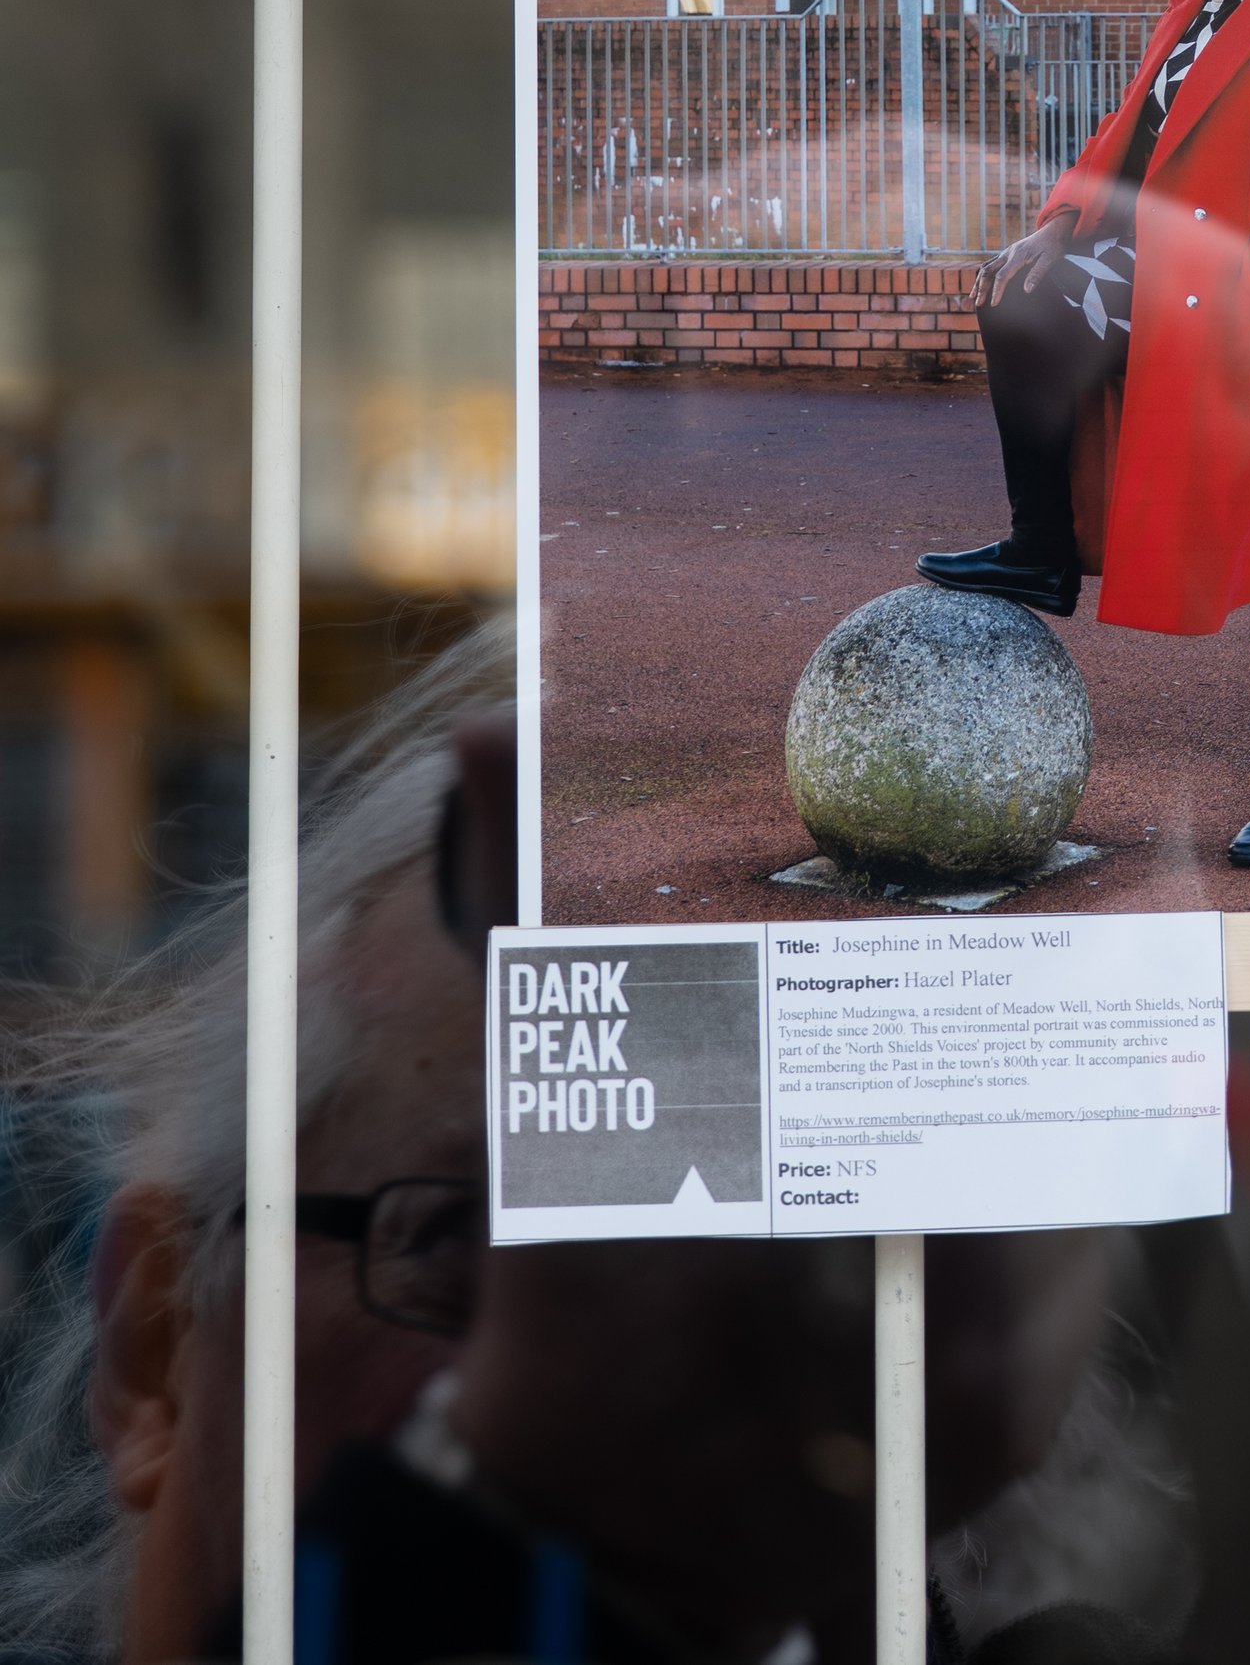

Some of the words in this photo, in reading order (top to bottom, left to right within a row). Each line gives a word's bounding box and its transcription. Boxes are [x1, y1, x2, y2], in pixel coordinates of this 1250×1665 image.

[776, 940, 820, 954] Title:
[832, 935, 920, 956] Josephine
[926, 936, 942, 950] in
[948, 933, 1025, 950] Meadow
[1031, 931, 1071, 947] Well
[509, 961, 630, 1015] DARK
[776, 975, 899, 993] Photographer:
[904, 971, 954, 988] Hazel
[961, 971, 1012, 987] Plater
[778, 1007, 838, 1023] Josephine
[842, 1006, 919, 1022] Mudzingwa,
[923, 1009, 930, 1017] a
[933, 1005, 981, 1017] resident
[986, 1003, 1000, 1015] of
[1002, 1001, 1055, 1015] Meadow
[1060, 1000, 1092, 1014] Well,
[1096, 999, 1131, 1012] North
[1135, 998, 1184, 1012] Shields,
[1188, 996, 1224, 1009] North
[779, 1024, 833, 1041] Tyneside
[837, 1023, 869, 1037] since
[872, 1023, 906, 1036] 2000.
[911, 1021, 938, 1034] This
[941, 1018, 1030, 1034] environmental
[1033, 1019, 1079, 1034] portrait
[1083, 1019, 1107, 1030] was
[1110, 1015, 1199, 1030] commissioned
[1202, 1017, 1216, 1027] as
[509, 1019, 628, 1073] PEAK
[778, 1044, 802, 1059] part
[806, 1043, 820, 1055] of
[822, 1042, 841, 1054] the
[846, 1040, 883, 1054] 'North
[888, 1039, 933, 1053] Shields
[937, 1038, 980, 1052] Voices'
[984, 1038, 1026, 1053] project
[1030, 1037, 1044, 1052] by
[1049, 1035, 1118, 1050] community
[1123, 1034, 1168, 1047] archive
[779, 1060, 865, 1075] Remembering
[869, 1059, 889, 1071] the
[892, 1058, 917, 1071] Past
[922, 1058, 933, 1070] in
[937, 1057, 956, 1069] the
[960, 1055, 1000, 1068] town's
[1003, 1054, 1038, 1068] 800th
[1042, 1057, 1070, 1070] year.
[1075, 1054, 1085, 1066] It
[1088, 1053, 1168, 1068] accompanies
[1171, 1051, 1206, 1064] audio
[779, 1079, 801, 1092] and
[805, 1082, 812, 1091] a
[815, 1076, 893, 1093] transcription
[897, 1077, 911, 1089] of
[914, 1074, 983, 1091] Josephine's
[987, 1073, 1030, 1088] stories.
[509, 1077, 655, 1133] PHOTO
[780, 1130, 923, 1147] living-in-north-shields/
[778, 1163, 831, 1178] Price:
[837, 1159, 877, 1177] NFS
[780, 1189, 860, 1205] Contact:
